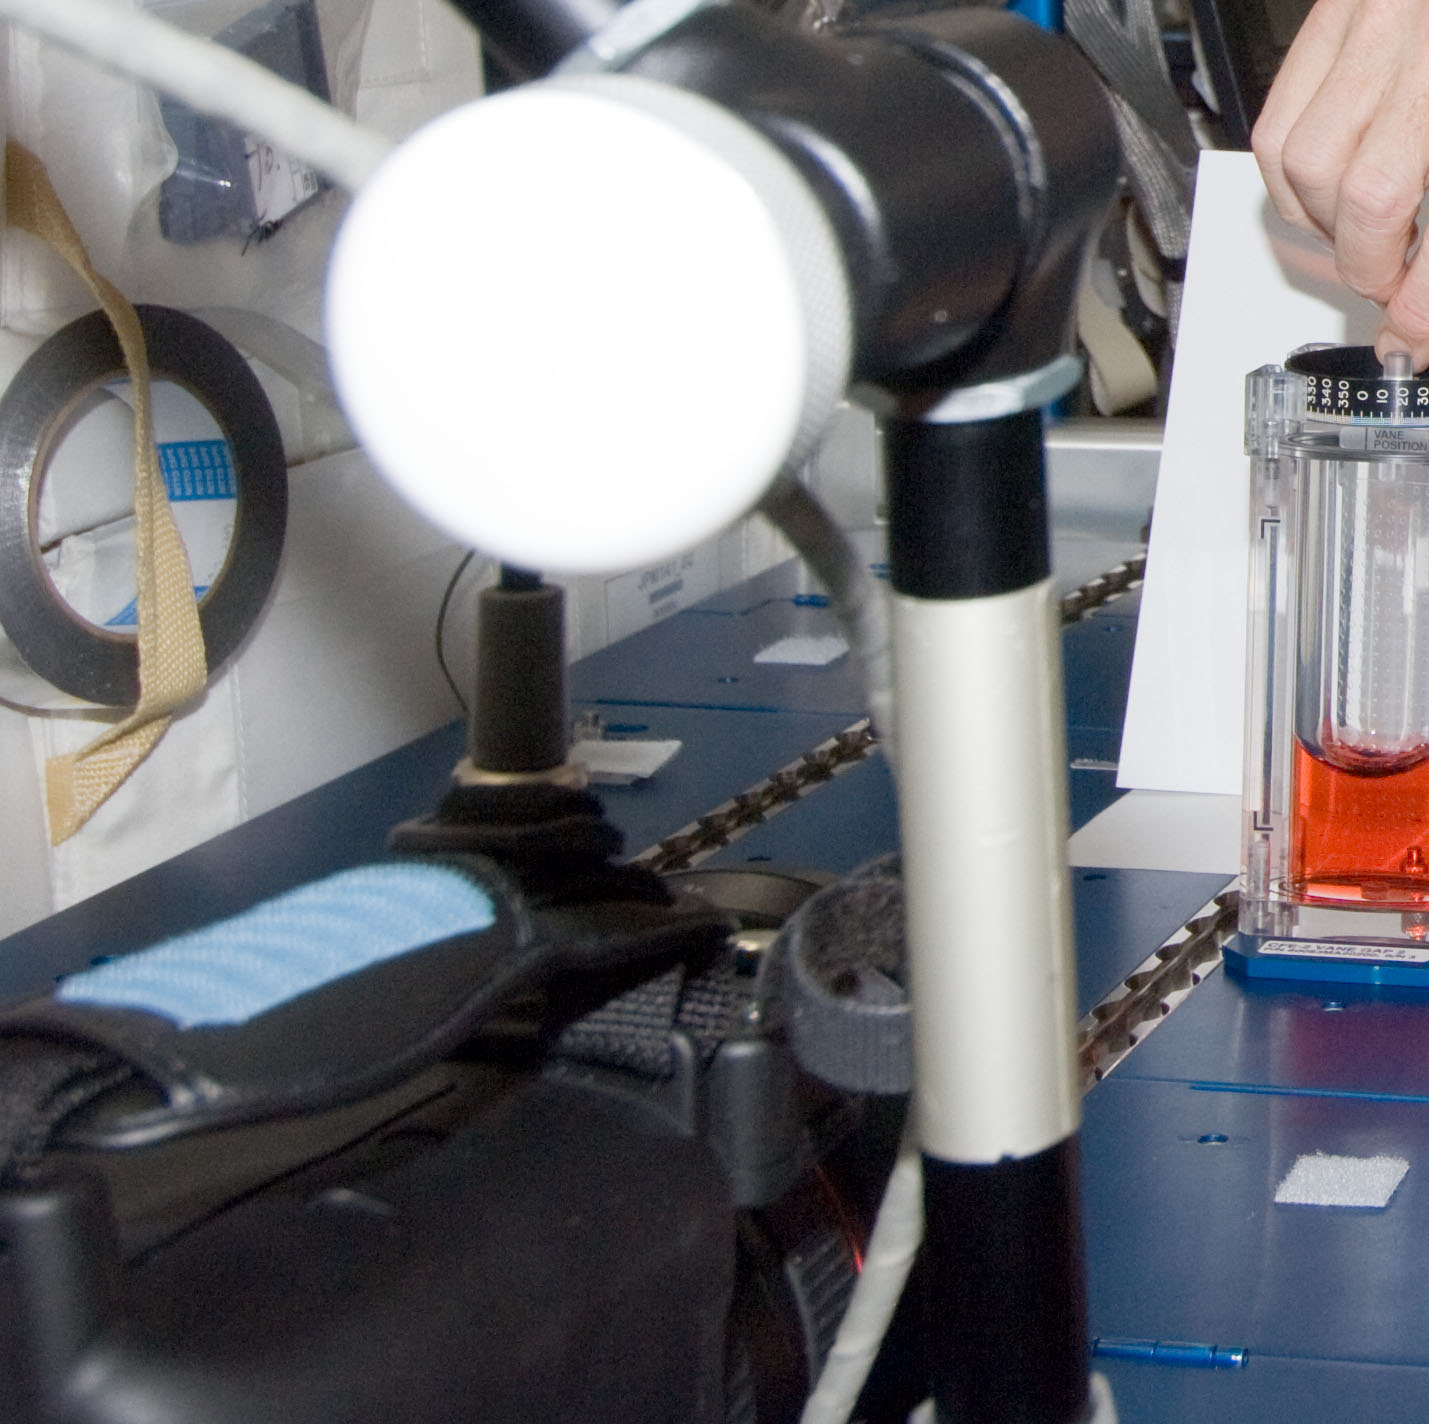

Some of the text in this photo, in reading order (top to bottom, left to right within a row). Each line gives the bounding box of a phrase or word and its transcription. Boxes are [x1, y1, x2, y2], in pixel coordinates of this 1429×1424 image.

[1307, 376, 1317, 404] 330
[1321, 378, 1332, 406] 340
[1338, 380, 1350, 408] 350
[1357, 390, 1369, 401] 0
[1376, 389, 1389, 404] 10
[1397, 387, 1410, 406] 20
[1417, 386, 1429, 406] 30
[1374, 429, 1405, 440] VANE
[1373, 440, 1428, 451] POSITION
